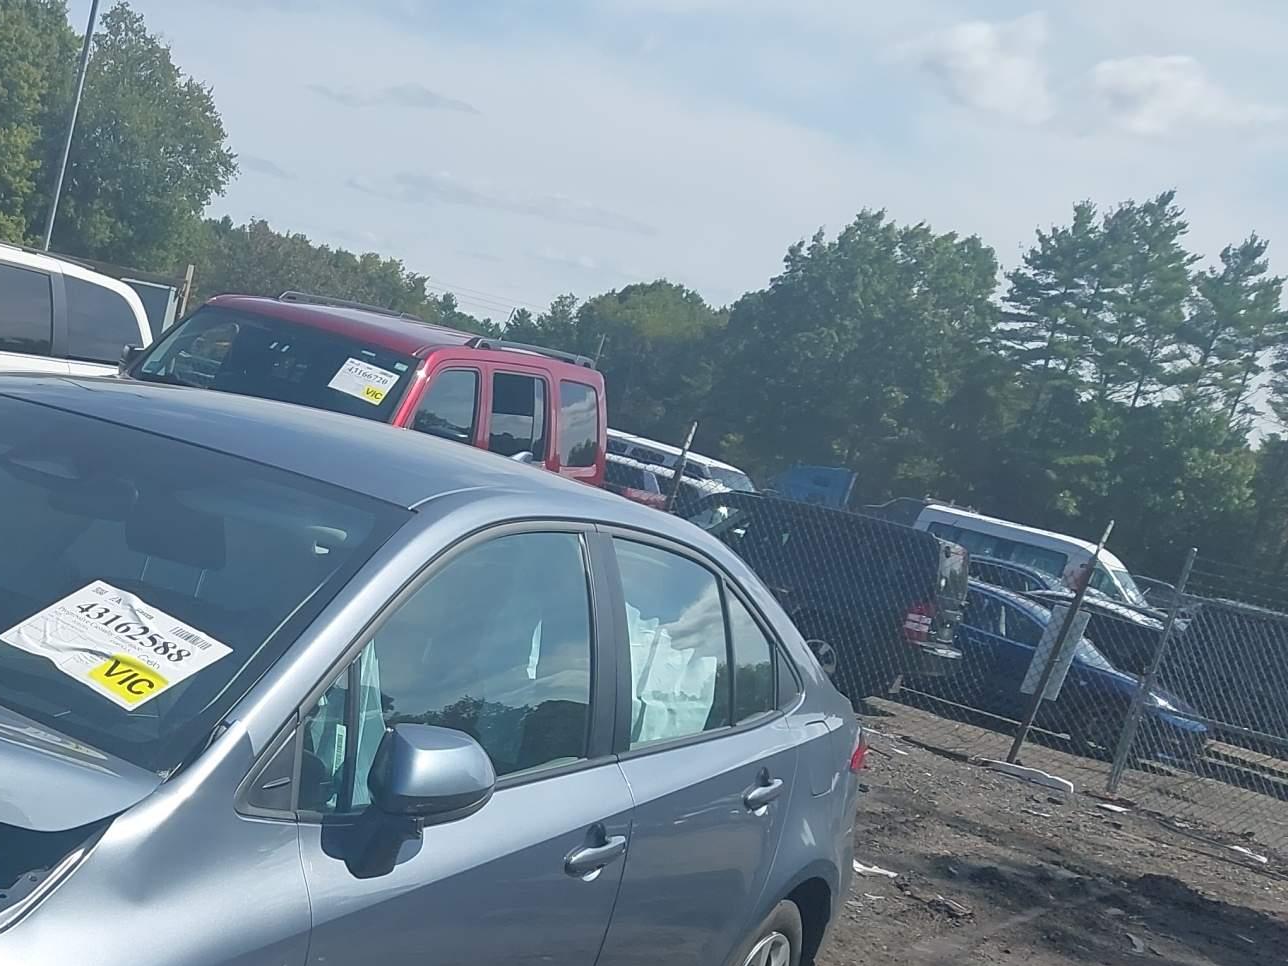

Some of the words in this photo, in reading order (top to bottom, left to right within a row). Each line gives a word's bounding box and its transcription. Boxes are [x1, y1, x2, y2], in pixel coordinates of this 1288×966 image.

[365, 387, 383, 400] VIC
[77, 603, 191, 662] 43162588
[104, 659, 155, 695] VIC
